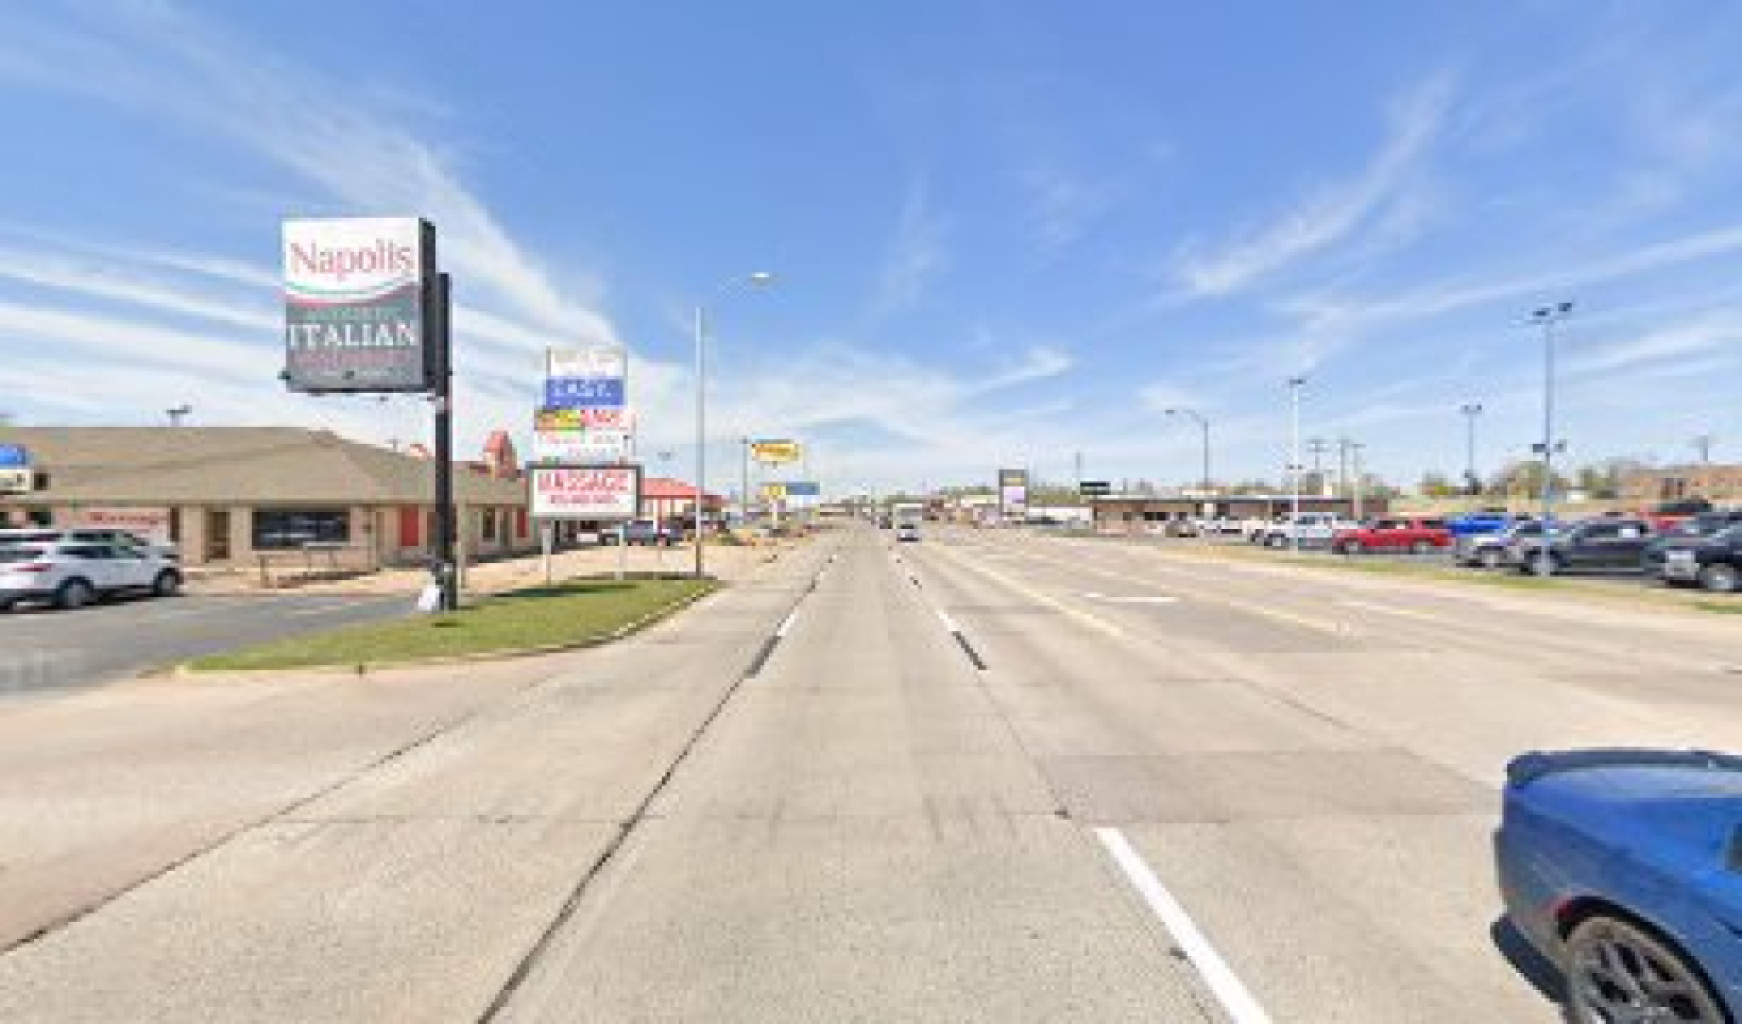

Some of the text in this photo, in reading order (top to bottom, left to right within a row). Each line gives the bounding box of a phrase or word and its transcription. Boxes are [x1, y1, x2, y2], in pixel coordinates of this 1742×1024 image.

[289, 238, 415, 281] Napolis
[287, 323, 417, 349] ITALIAN
[537, 469, 629, 491] MASSAGE
